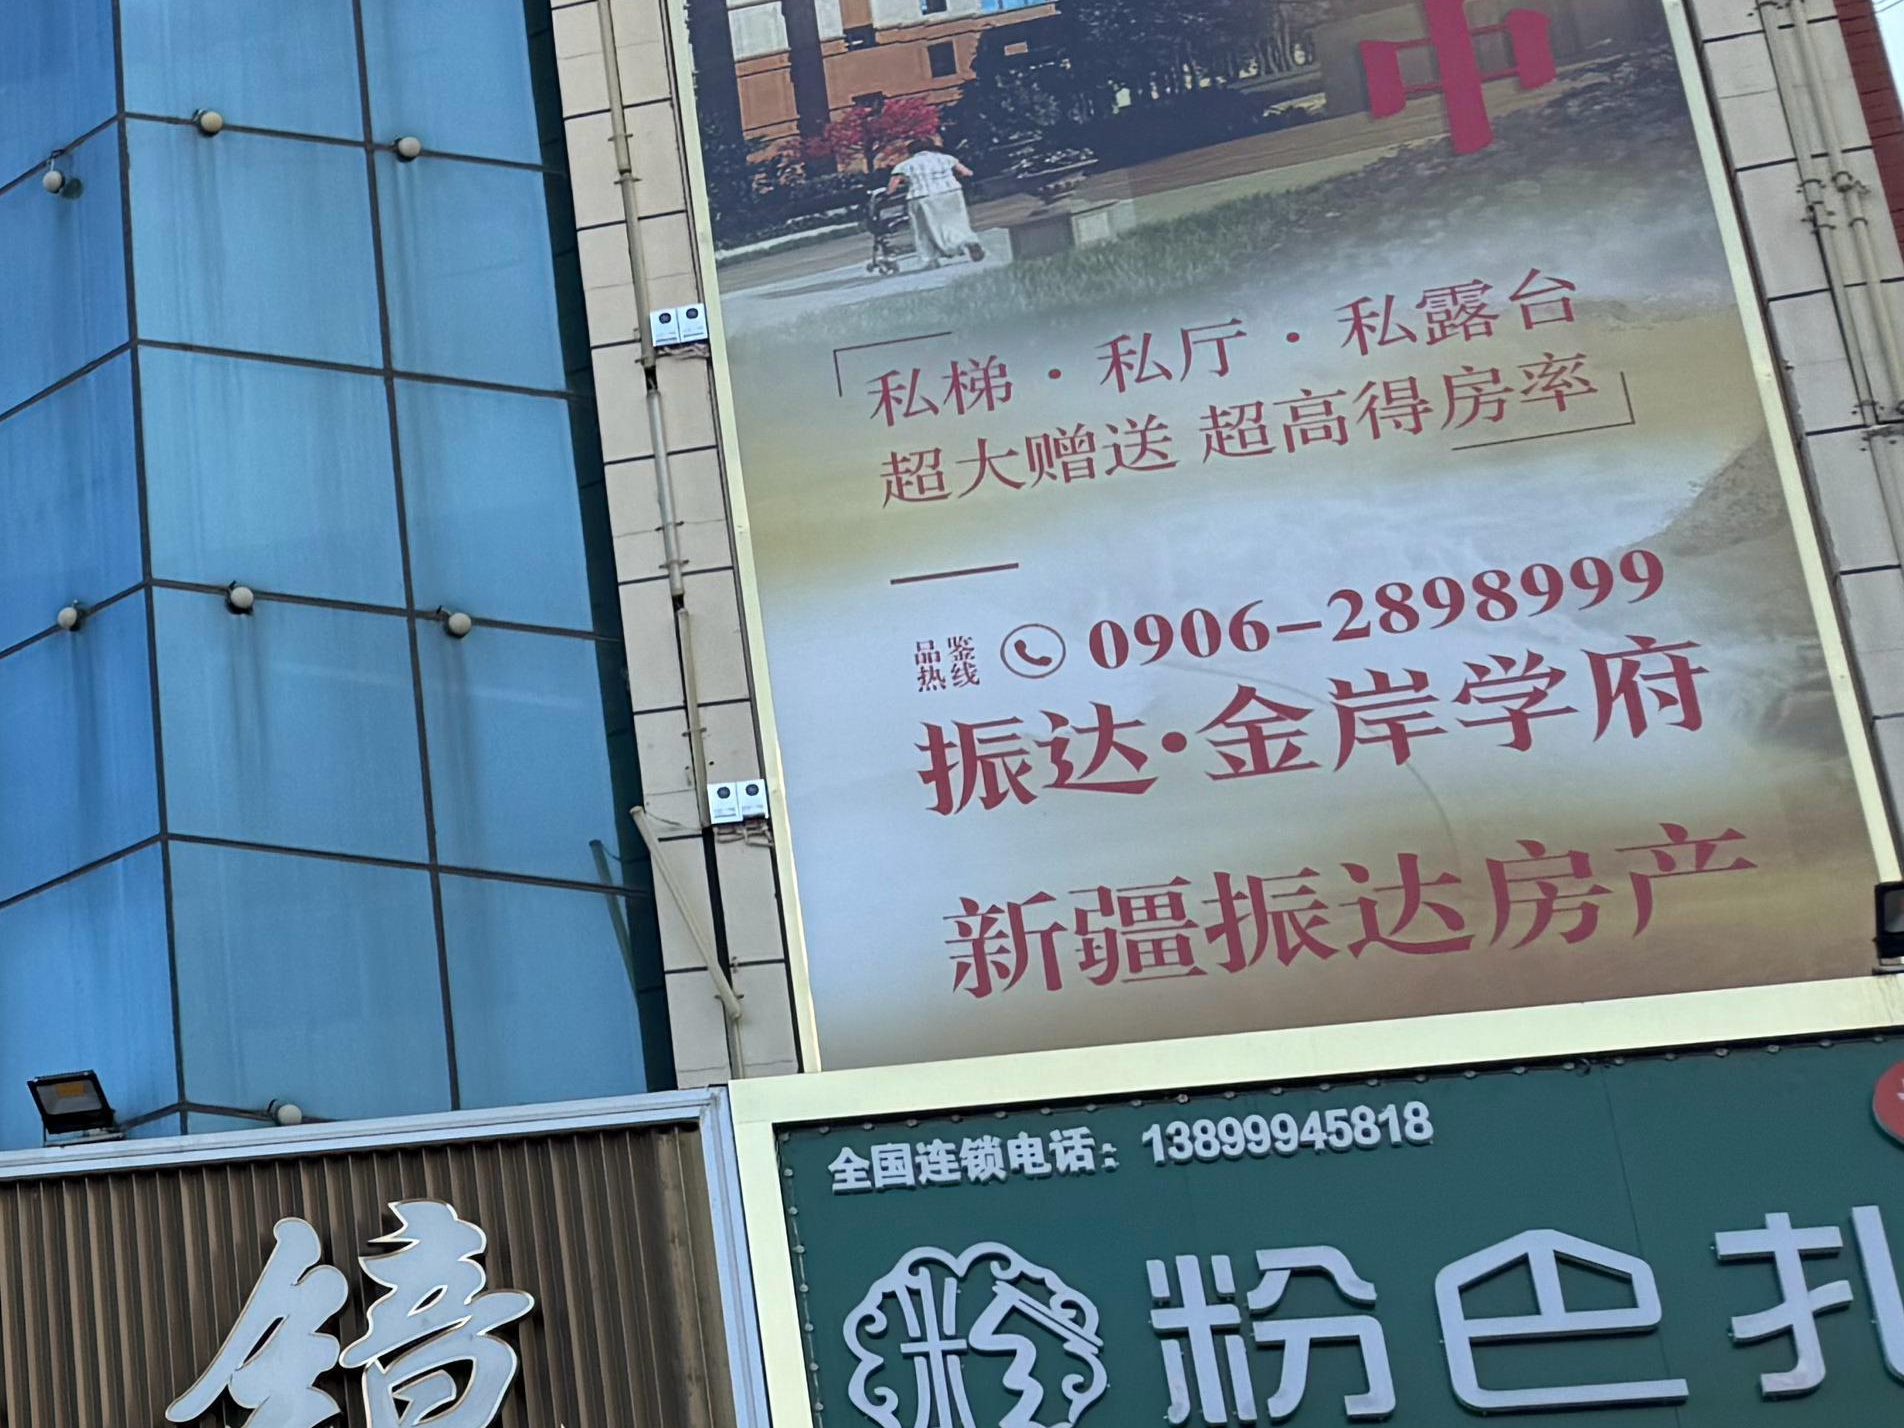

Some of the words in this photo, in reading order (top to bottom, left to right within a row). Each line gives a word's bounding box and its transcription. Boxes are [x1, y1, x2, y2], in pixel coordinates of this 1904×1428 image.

[881, 416, 1180, 509] 超大赠送
[1202, 352, 1600, 467] 超高得房率
[1088, 548, 1666, 671] 0906-2898999
[914, 633, 1710, 817] 振达·金岸学府
[941, 823, 1757, 1000] 新疆振达房产
[828, 1125, 1118, 1195] 全国连锁电话：
[1140, 1100, 1435, 1166] 13899945818
